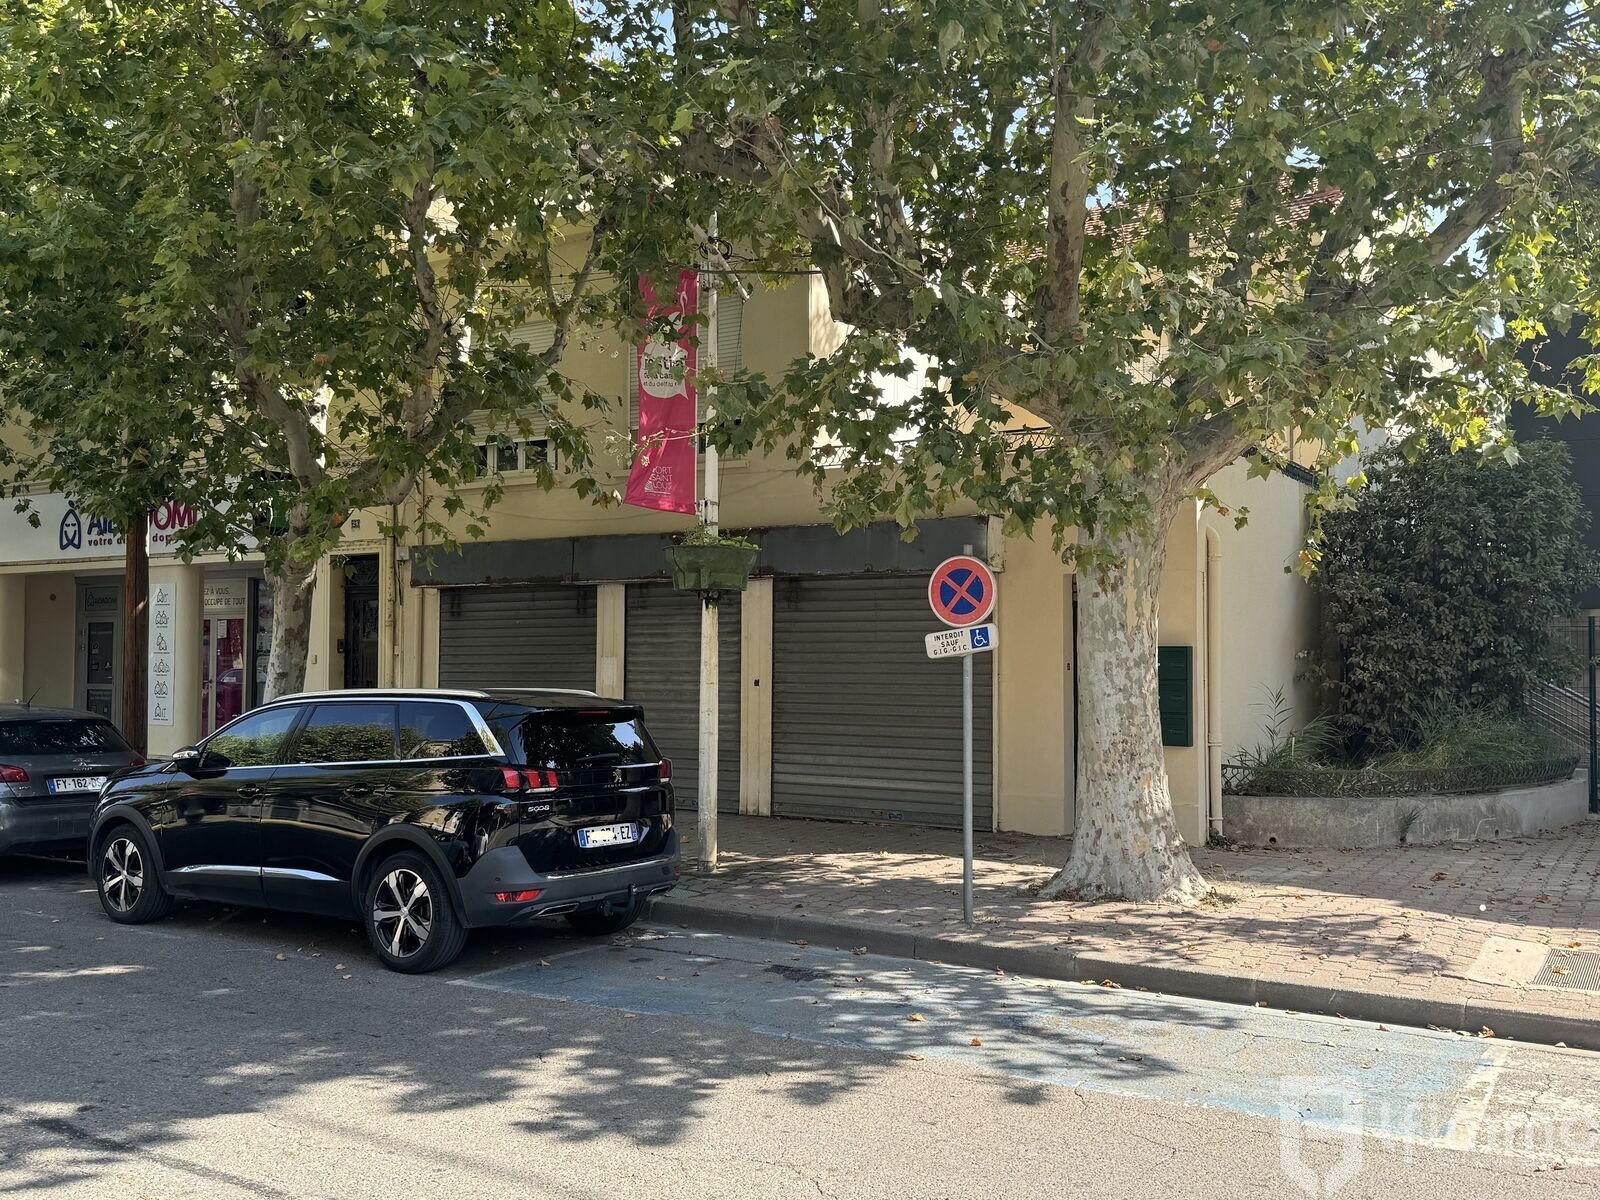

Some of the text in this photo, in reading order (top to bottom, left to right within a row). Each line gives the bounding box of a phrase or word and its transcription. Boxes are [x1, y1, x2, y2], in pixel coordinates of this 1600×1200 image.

[88, 536, 113, 547] votre
[232, 597, 246, 605] TOUT
[934, 630, 964, 641] INTERDIT
[940, 639, 959, 648] SAUF
